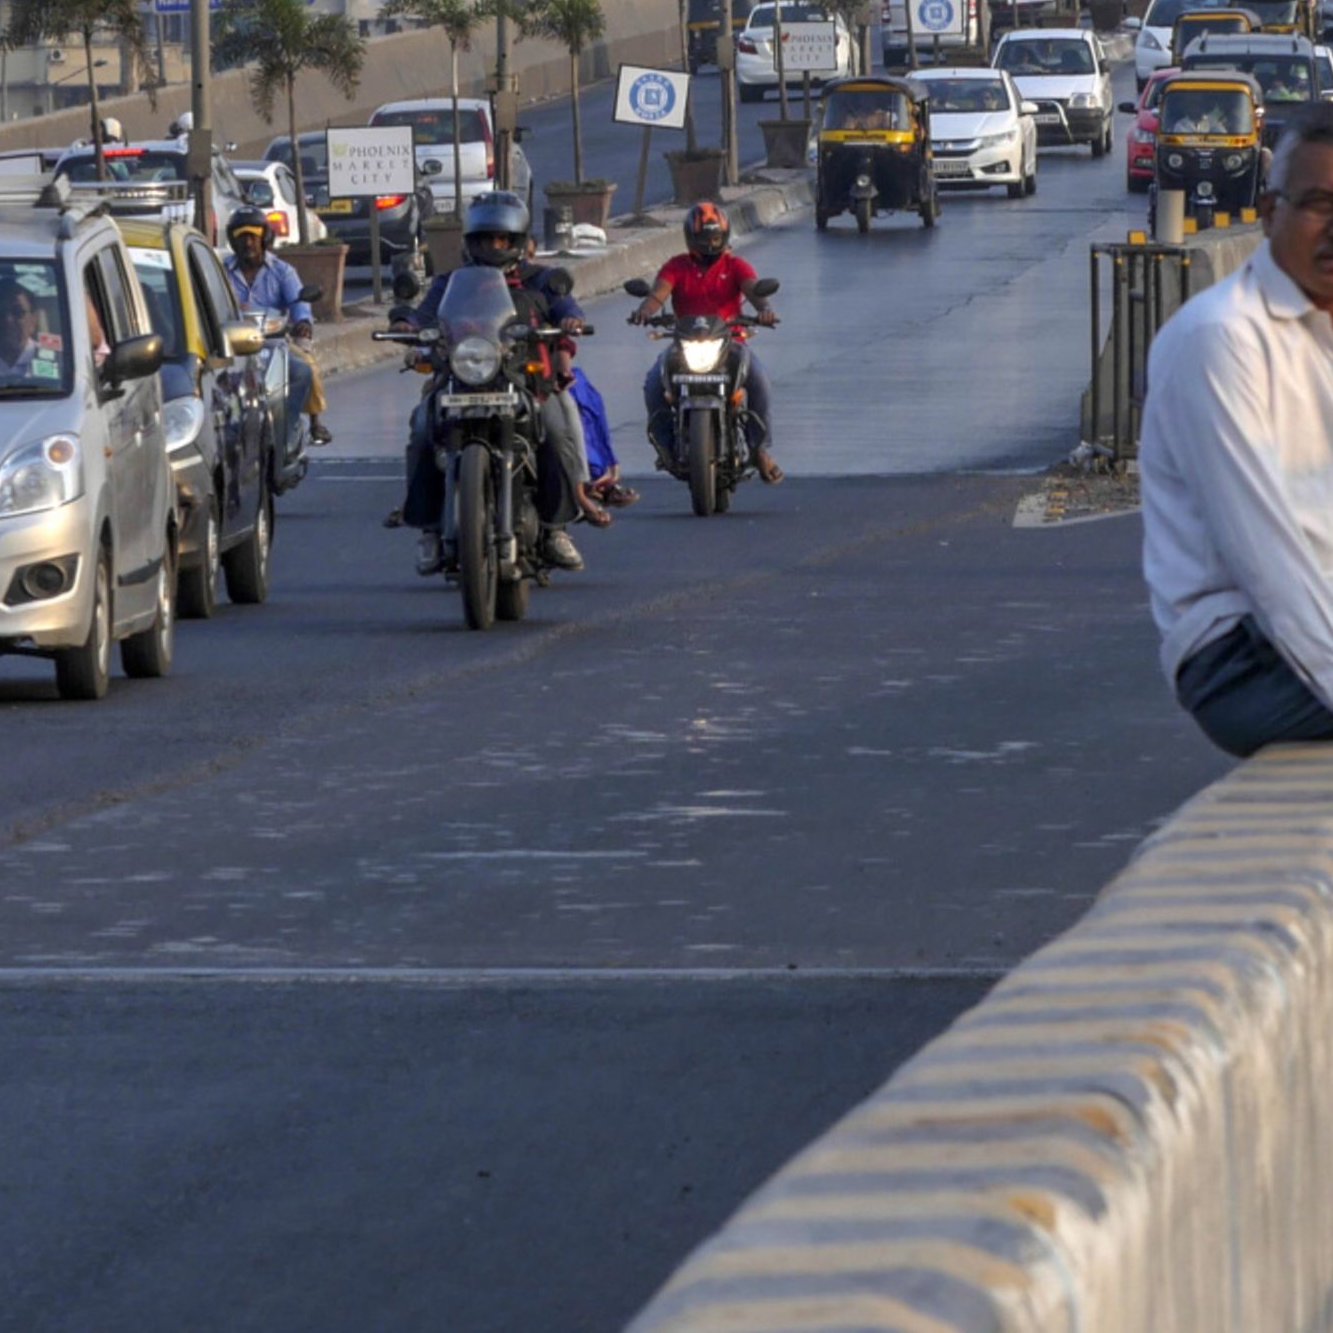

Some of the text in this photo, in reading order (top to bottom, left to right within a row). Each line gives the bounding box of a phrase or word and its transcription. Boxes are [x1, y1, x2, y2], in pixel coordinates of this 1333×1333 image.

[348, 145, 410, 157] PHOENIX
[332, 160, 410, 171] MARKET
[351, 174, 392, 185] CITY
